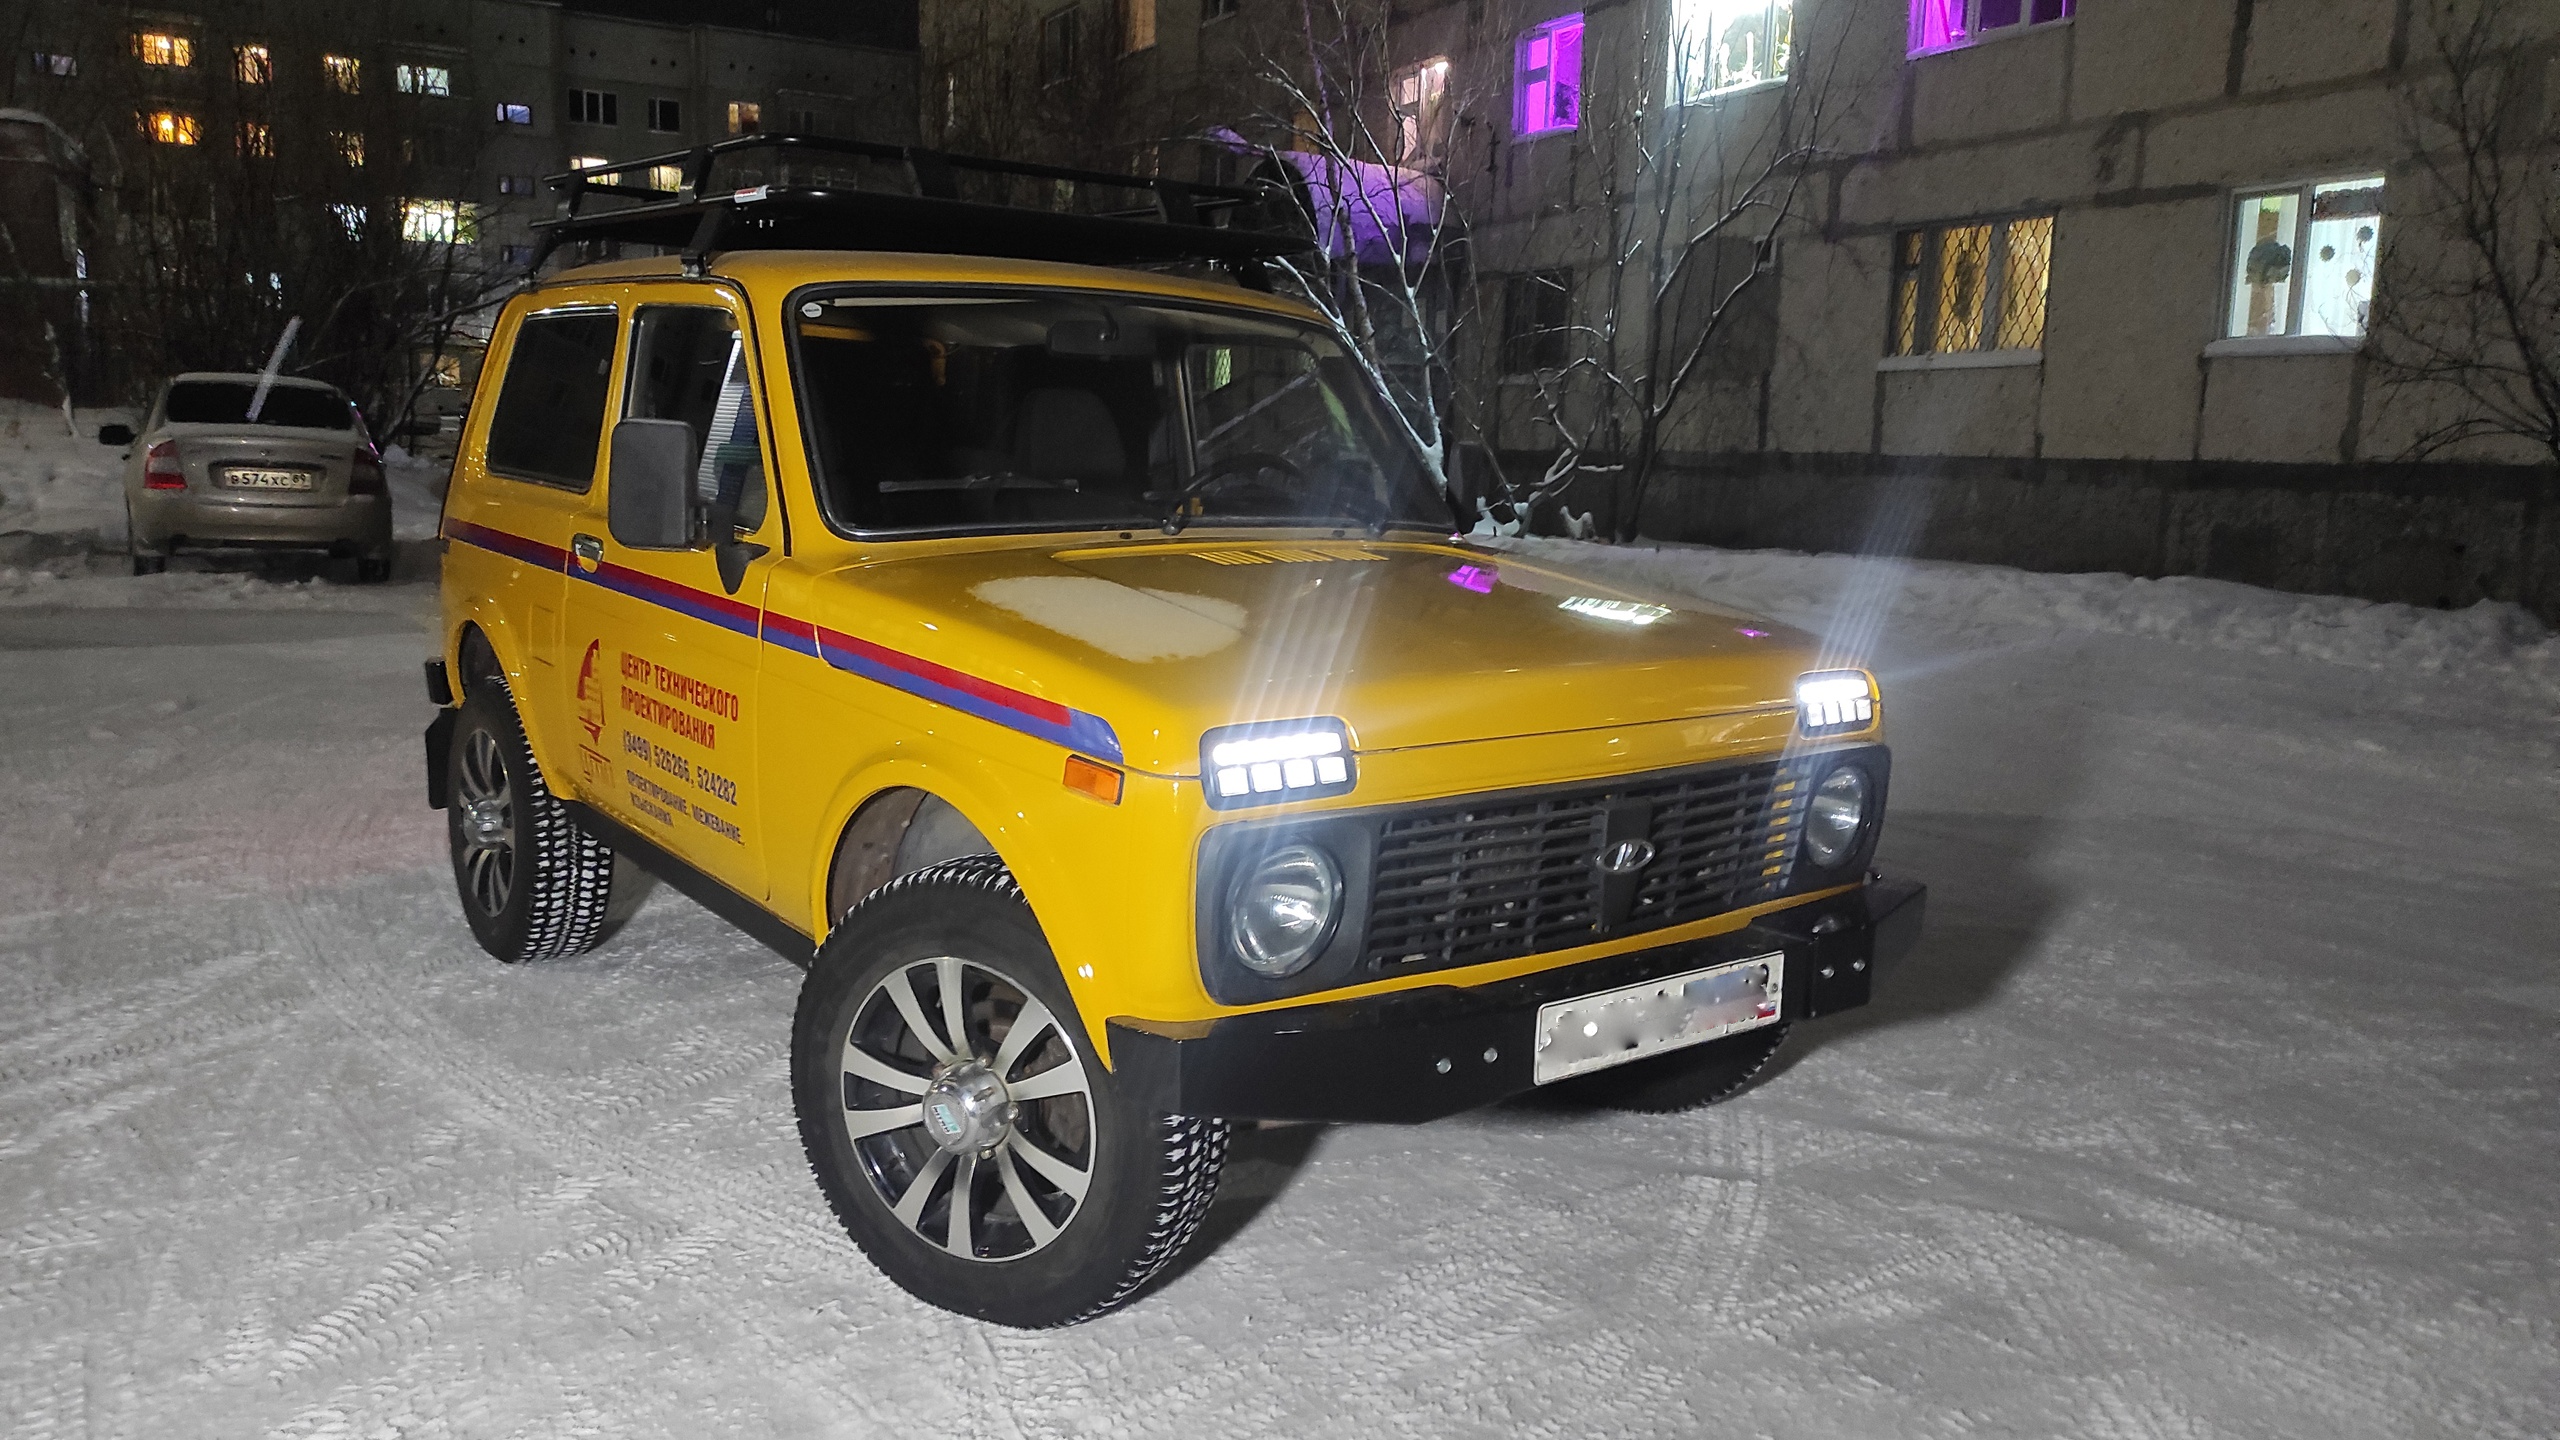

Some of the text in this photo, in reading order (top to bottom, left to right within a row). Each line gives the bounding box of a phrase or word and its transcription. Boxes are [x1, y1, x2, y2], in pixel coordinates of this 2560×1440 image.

[621, 651, 739, 722] ЦЕНТР ТЕХНИЧЕСКОГО
[621, 684, 715, 750] ПРОЕКТИРОВАНИЯ
[697, 765, 738, 807] 524282
